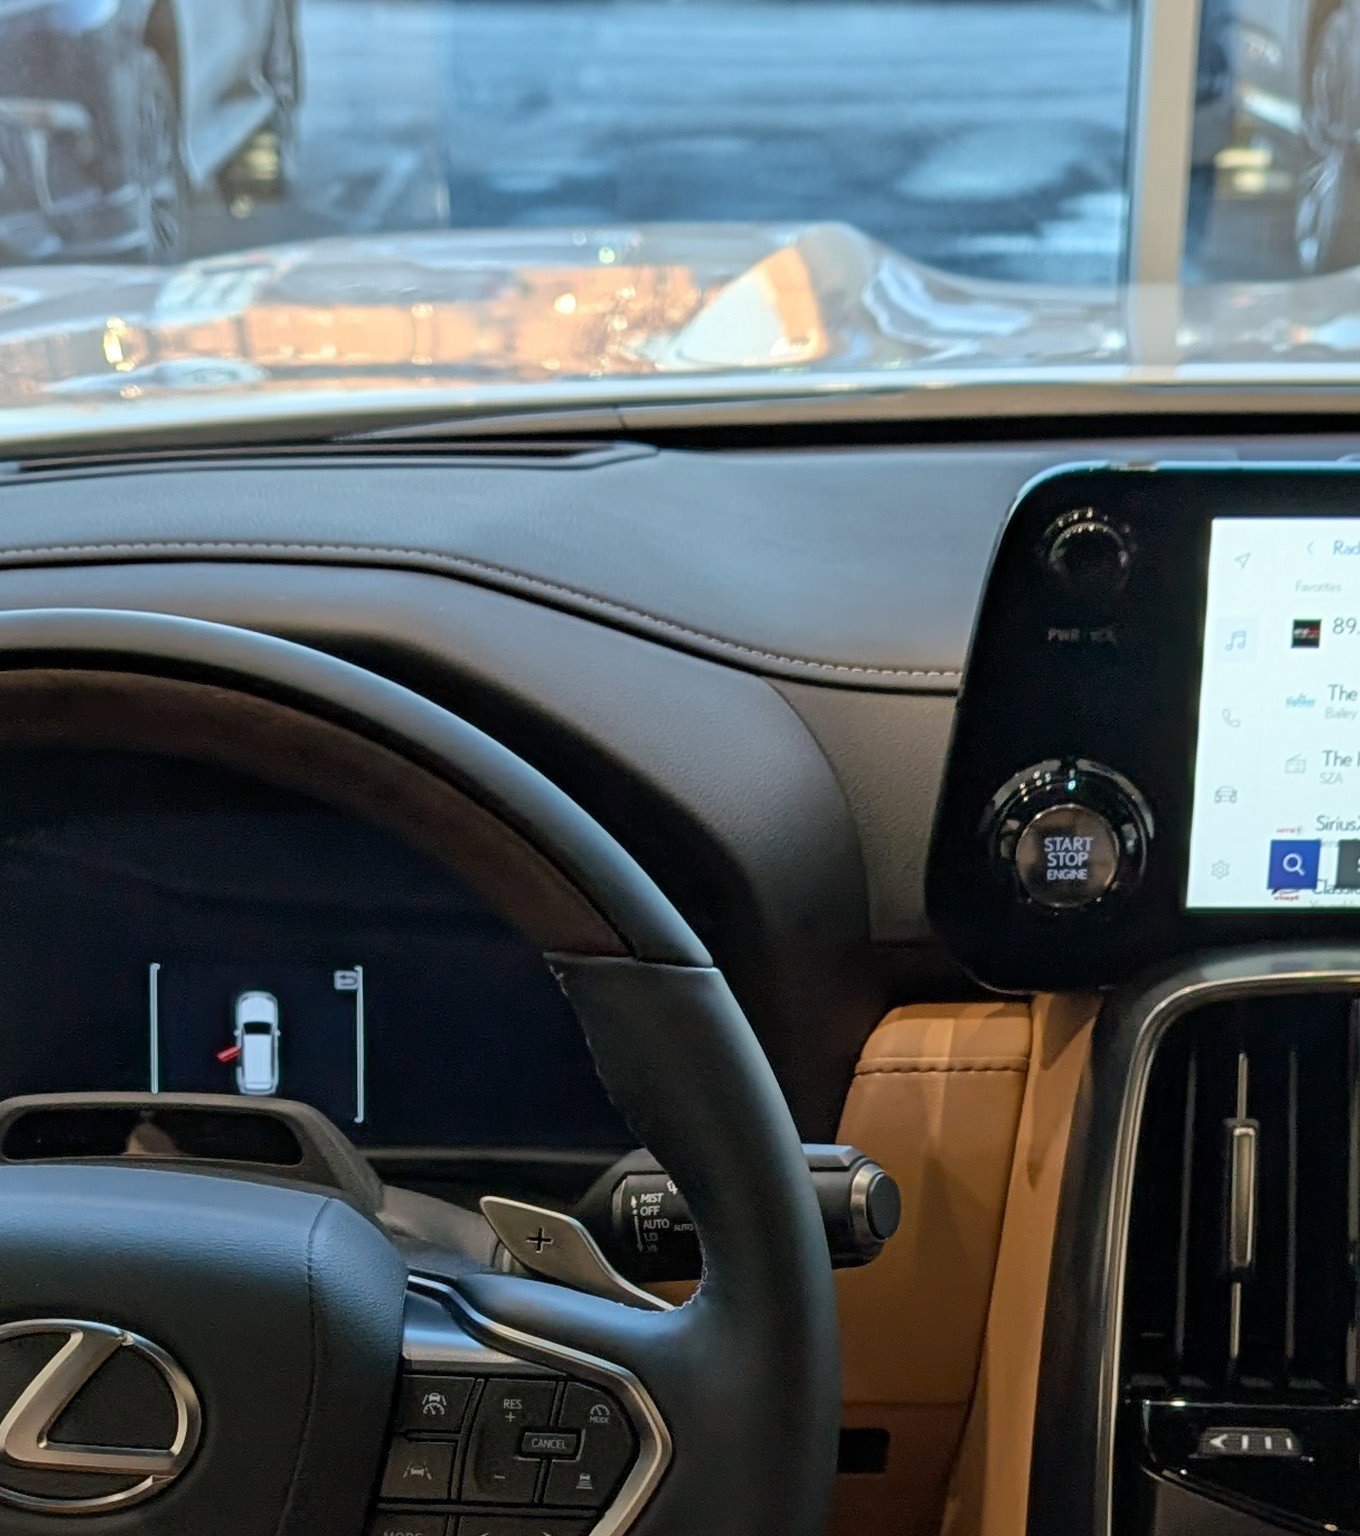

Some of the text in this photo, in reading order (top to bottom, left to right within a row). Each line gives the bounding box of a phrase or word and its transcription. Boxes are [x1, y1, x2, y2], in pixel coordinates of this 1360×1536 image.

[1295, 580, 1342, 593] Favorites
[1328, 684, 1358, 701] The
[1323, 750, 1352, 767] The
[1320, 773, 1343, 785] SZA
[1044, 837, 1094, 852] START
[1047, 852, 1089, 867] STOP
[1046, 868, 1088, 881] ENGINE
[640, 1192, 663, 1203] MIST
[640, 1205, 660, 1216] OFF
[643, 1218, 669, 1229] AUTO
[503, 1399, 523, 1410] RES
[531, 1438, 567, 1450] CANCEL
